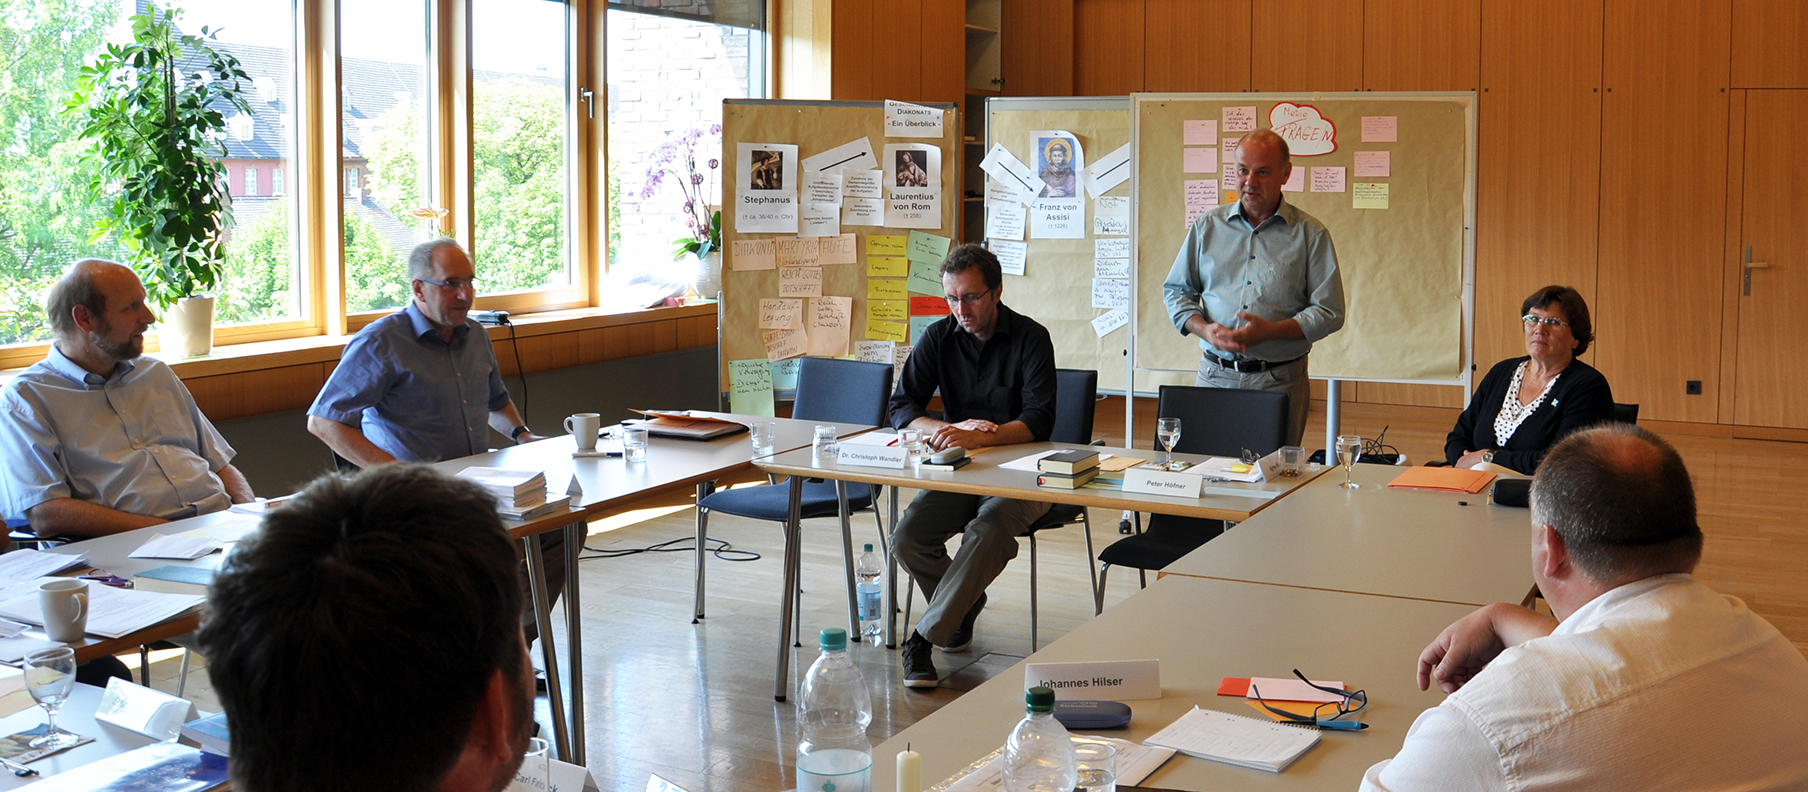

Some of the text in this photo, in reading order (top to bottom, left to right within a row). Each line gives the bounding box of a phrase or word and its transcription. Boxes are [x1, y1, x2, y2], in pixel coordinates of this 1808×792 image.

[1283, 106, 1308, 118] Meine
[744, 196, 790, 205] Stephanus
[734, 242, 775, 256] DIAKONIA
[778, 240, 818, 254] MARTYRIA
[851, 453, 877, 461] Christoph
[1037, 677, 1123, 689] Johannes Hilser
[514, 772, 531, 784] Carl
